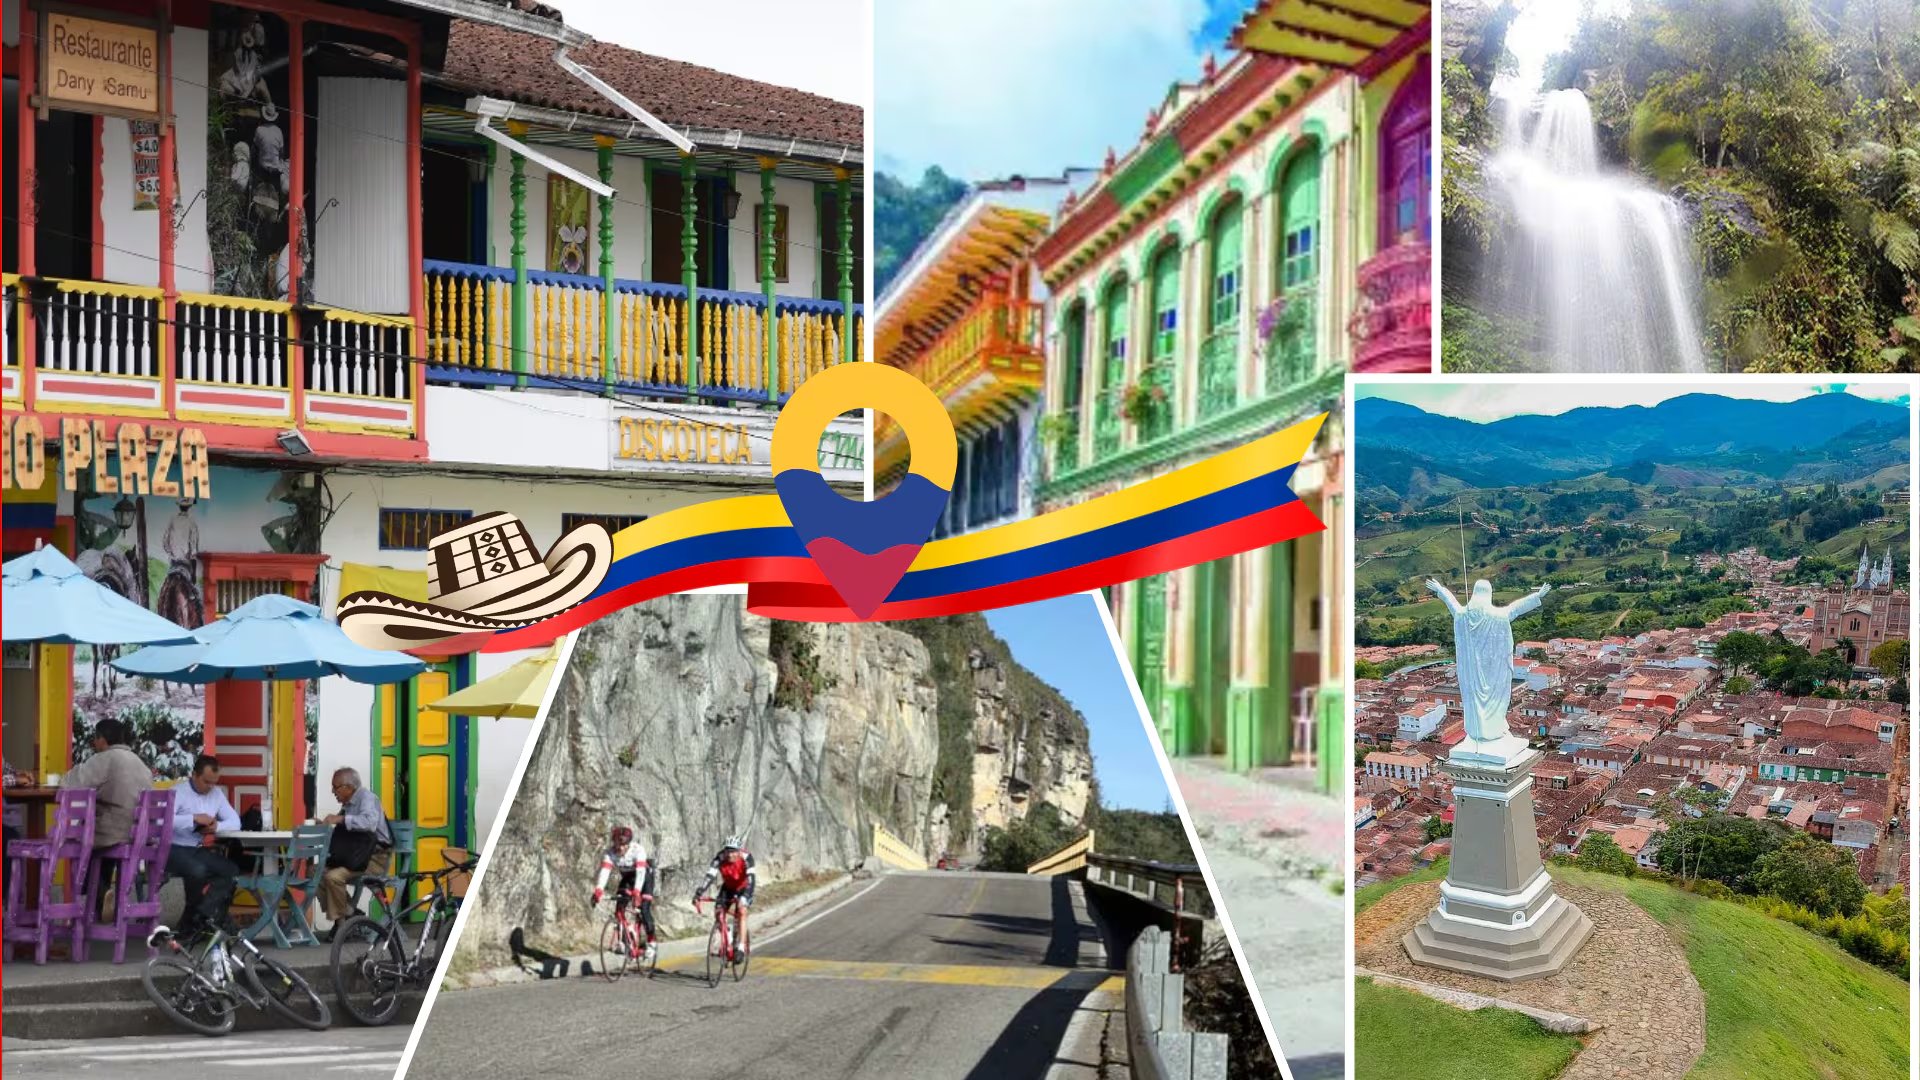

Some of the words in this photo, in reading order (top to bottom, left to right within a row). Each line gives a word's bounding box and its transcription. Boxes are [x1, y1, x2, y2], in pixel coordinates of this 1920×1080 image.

[53, 24, 153, 69] Restaurante
[57, 68, 96, 96] Dany
[62, 417, 210, 499] PLAZA
[619, 415, 752, 465] DISCOTECA
